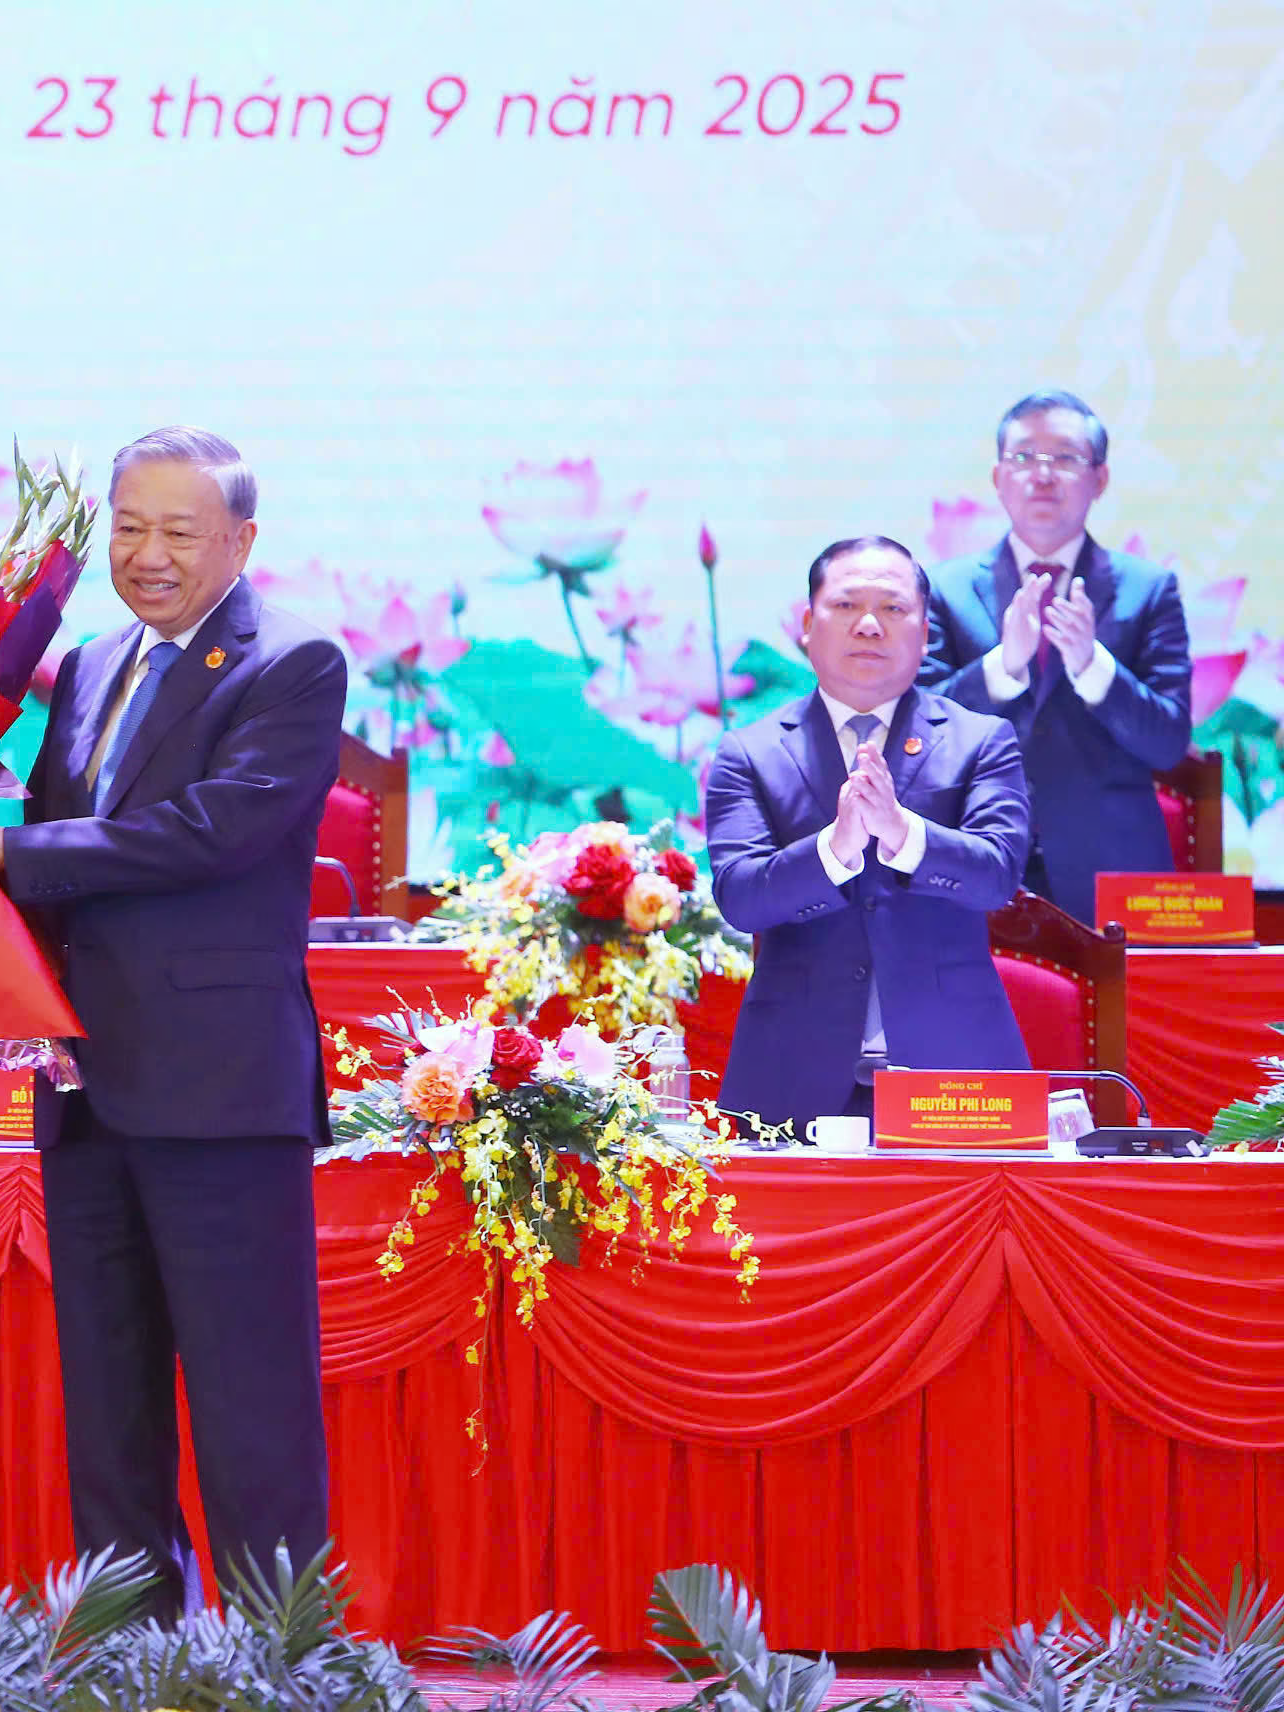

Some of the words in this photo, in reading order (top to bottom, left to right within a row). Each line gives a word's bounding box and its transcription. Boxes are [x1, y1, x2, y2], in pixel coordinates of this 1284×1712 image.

[27, 76, 118, 140] 23
[151, 75, 390, 157] tháng
[425, 75, 469, 135] 9
[496, 78, 675, 138] năm
[704, 72, 906, 138] 2025
[909, 1092, 957, 1112] NGUYỄN
[959, 1097, 979, 1112] PHI
[981, 1097, 1013, 1112] LONG
